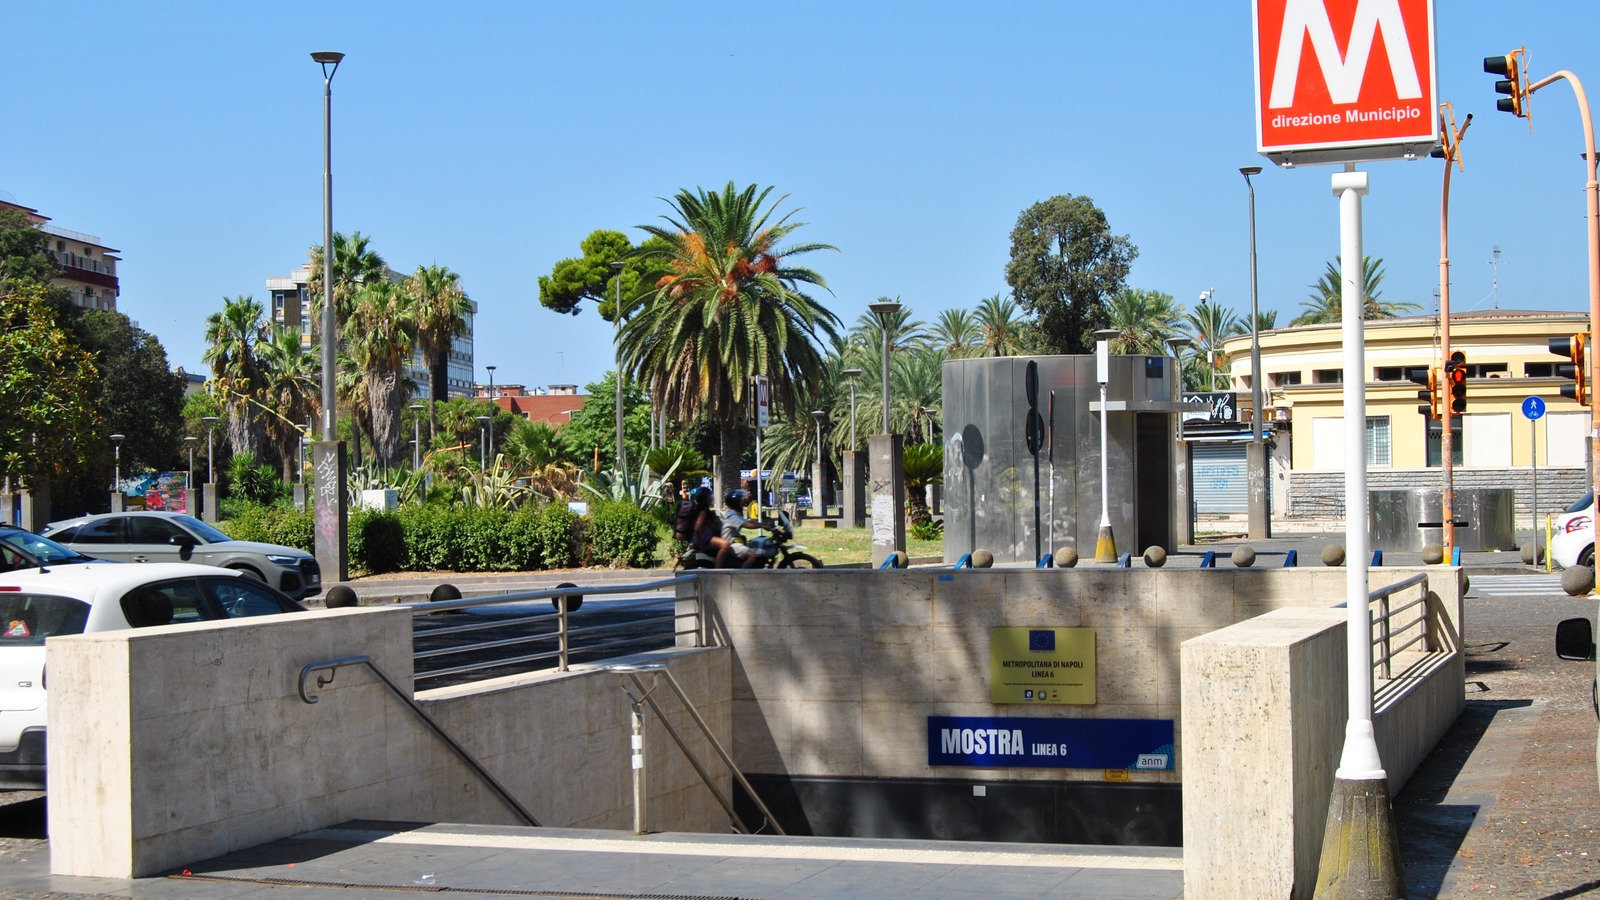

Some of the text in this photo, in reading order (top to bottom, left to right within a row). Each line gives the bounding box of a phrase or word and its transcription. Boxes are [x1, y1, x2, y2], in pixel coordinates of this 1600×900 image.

[1269, 0, 1423, 109] M
[1272, 106, 1421, 128] direzione Municipio
[1002, 660, 1052, 668] METROPOLITANA
[941, 728, 1067, 756] MOSTRA LINEA 6
[1141, 757, 1163, 766] anm
